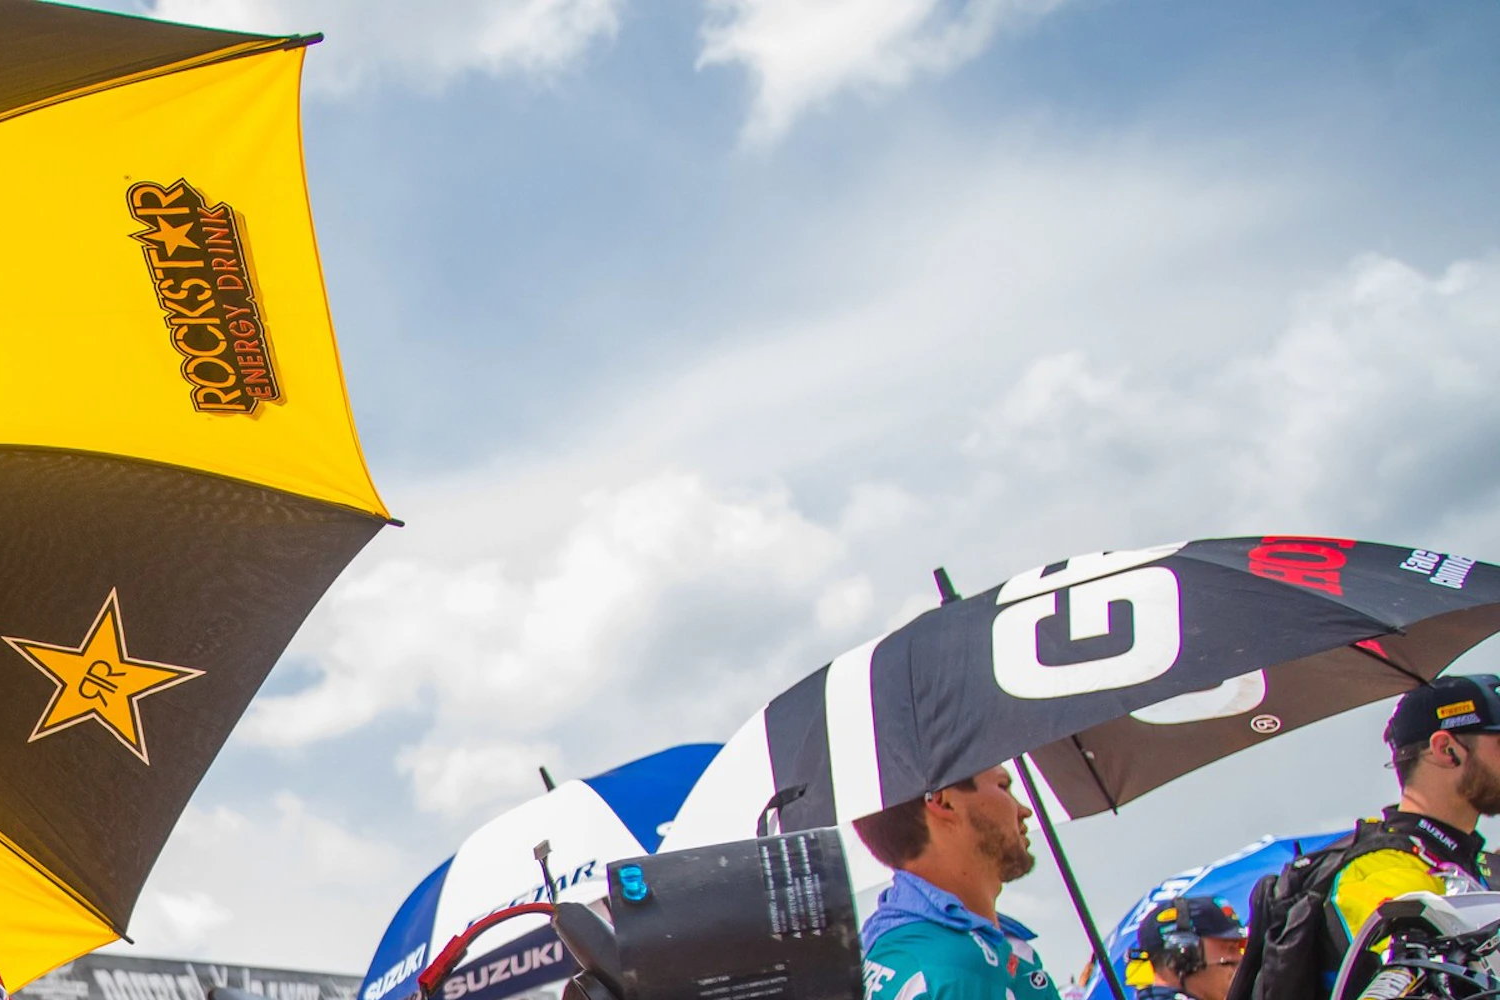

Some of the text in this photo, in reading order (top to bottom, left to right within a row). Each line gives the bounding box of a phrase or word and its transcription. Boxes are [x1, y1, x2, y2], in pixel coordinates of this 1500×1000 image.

[202, 208, 274, 400] ENERGY DRINK
[1417, 818, 1457, 851] SUZUKI
